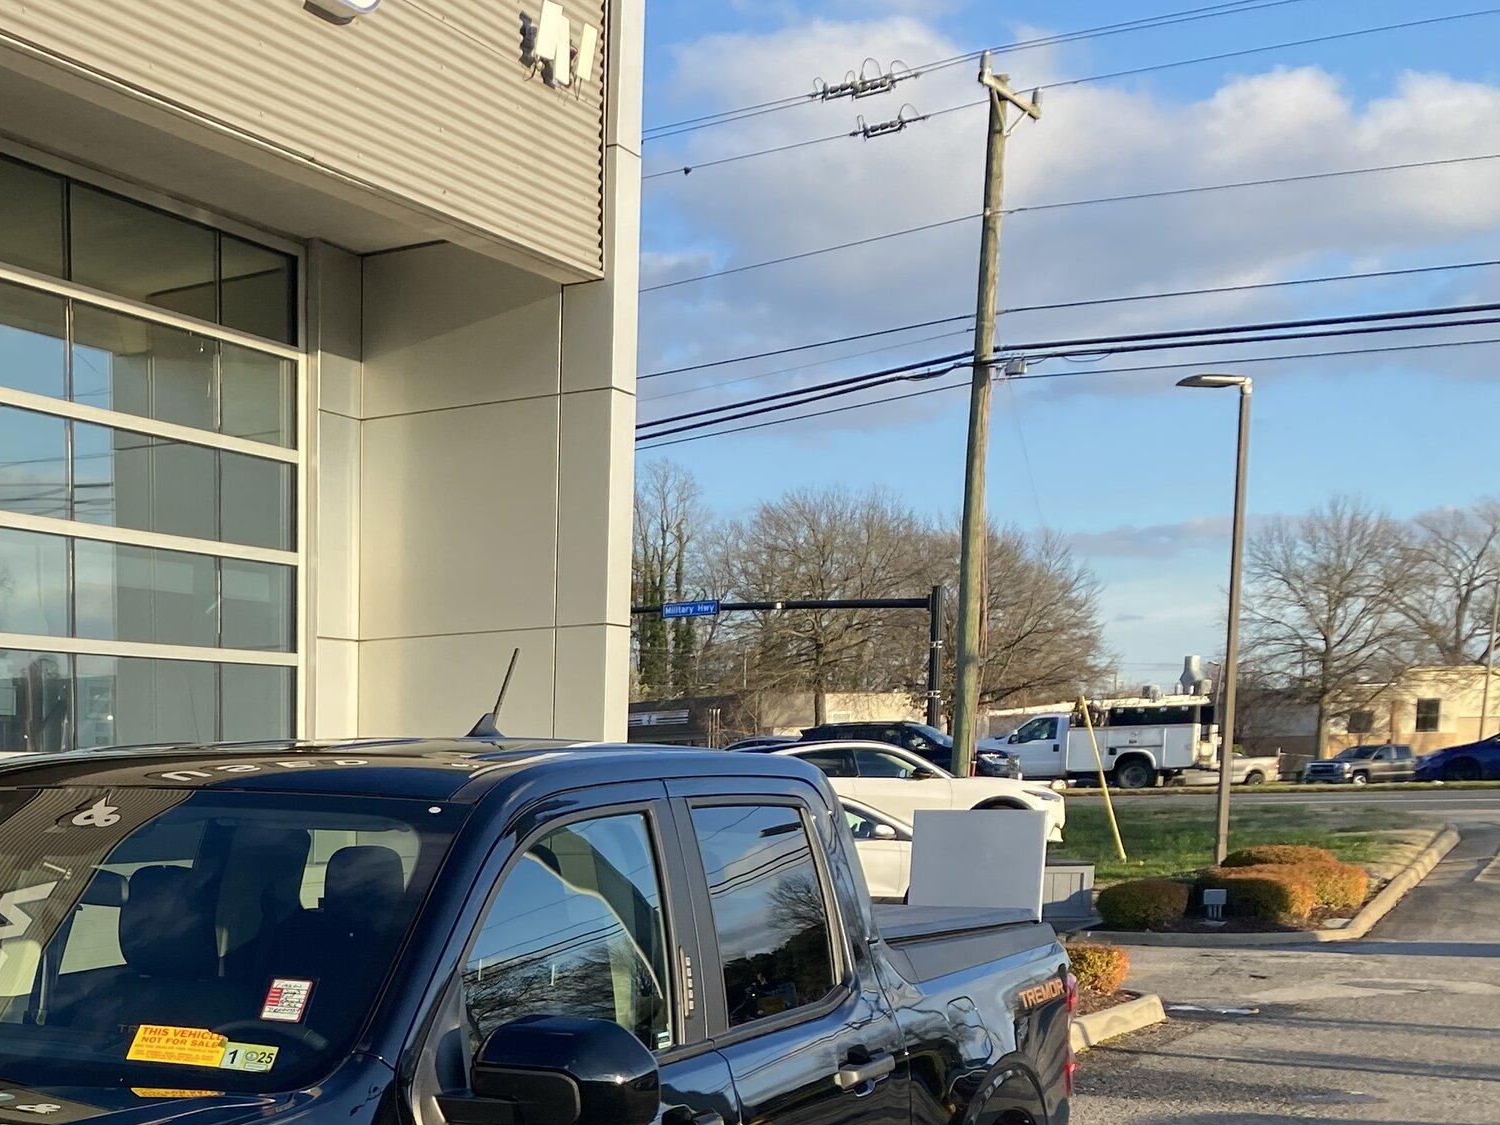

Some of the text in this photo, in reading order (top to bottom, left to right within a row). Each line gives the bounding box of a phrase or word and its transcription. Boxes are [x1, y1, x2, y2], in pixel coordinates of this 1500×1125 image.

[665, 603, 715, 615] Military Hwy
[1019, 978, 1065, 1008] TREMOR
[143, 1026, 169, 1037] THIS
[141, 1036, 220, 1049] NOT FOR SALE
[229, 1049, 238, 1064] 1
[257, 1052, 275, 1064] 25
